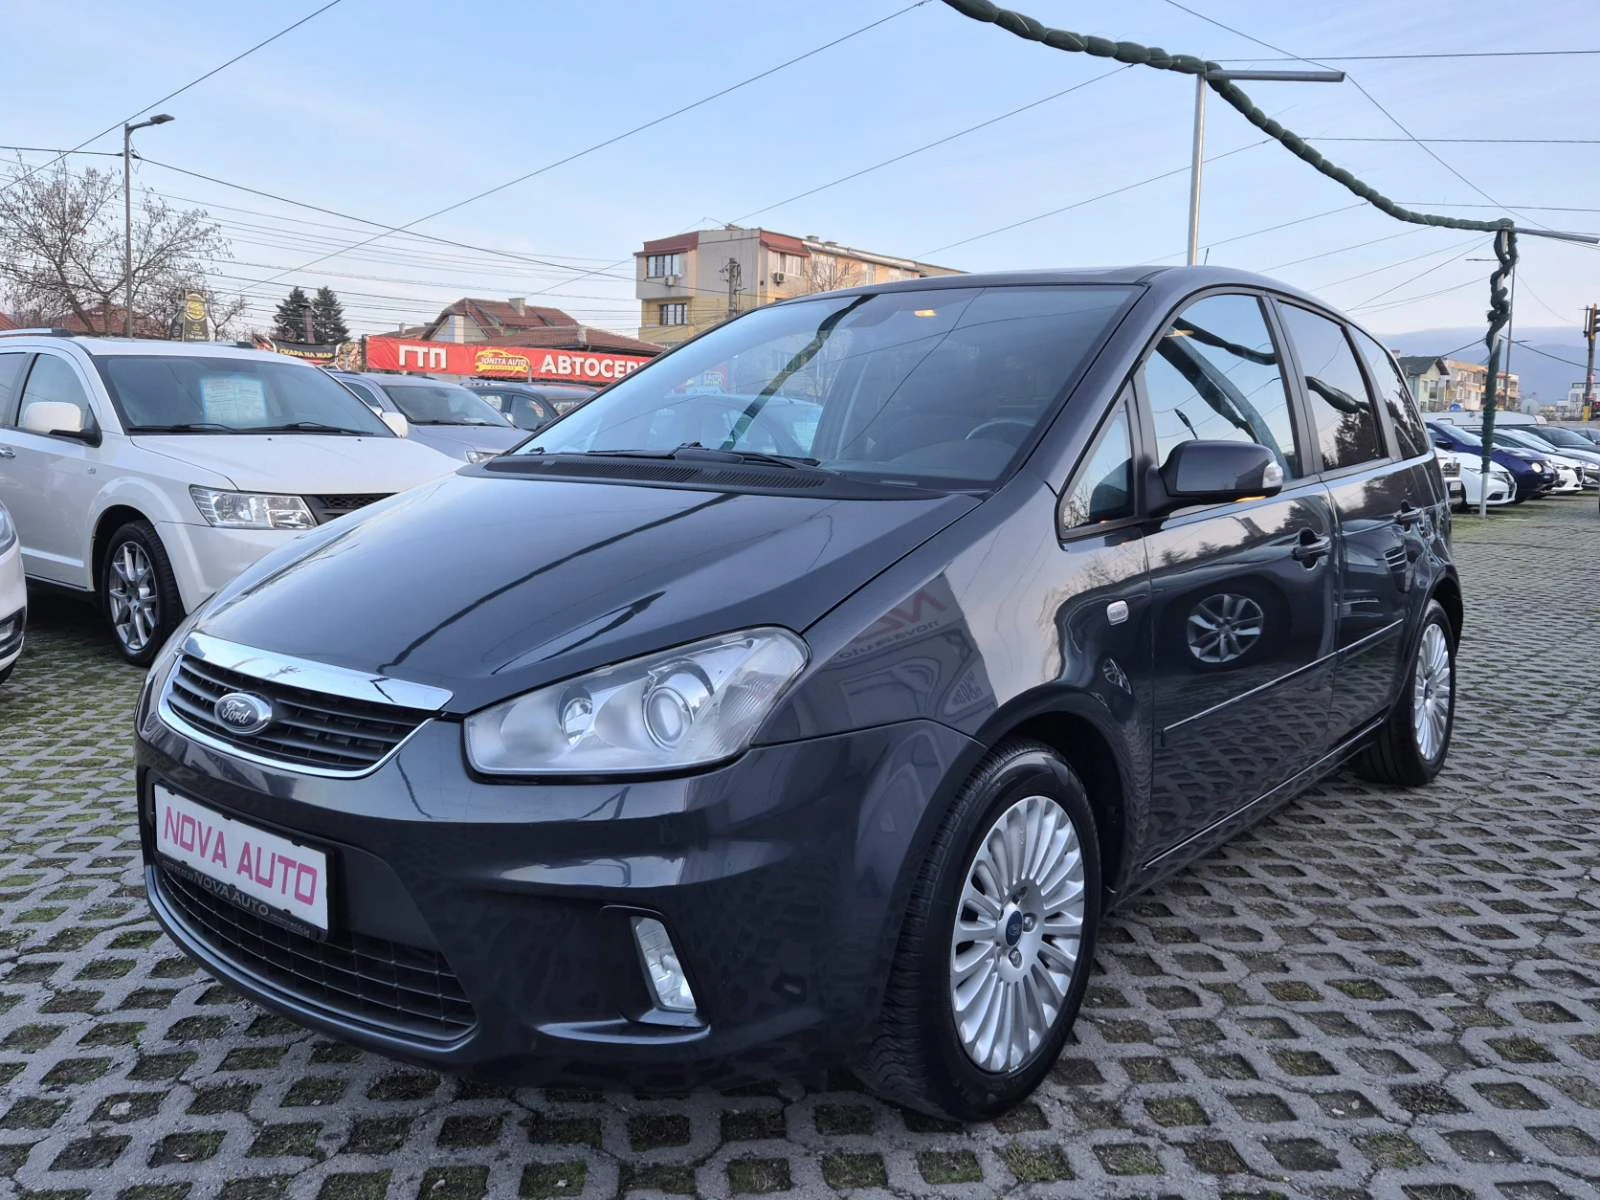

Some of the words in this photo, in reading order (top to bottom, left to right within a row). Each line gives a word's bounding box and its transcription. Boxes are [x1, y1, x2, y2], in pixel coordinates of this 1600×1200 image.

[399, 344, 447, 369] ГТП
[540, 354, 646, 378] АВТОСЕР
[221, 700, 252, 724] Ford
[164, 806, 228, 869] NOVA
[236, 841, 318, 906] AUTO
[193, 872, 230, 898] NOVA
[232, 890, 270, 916] AUTO
